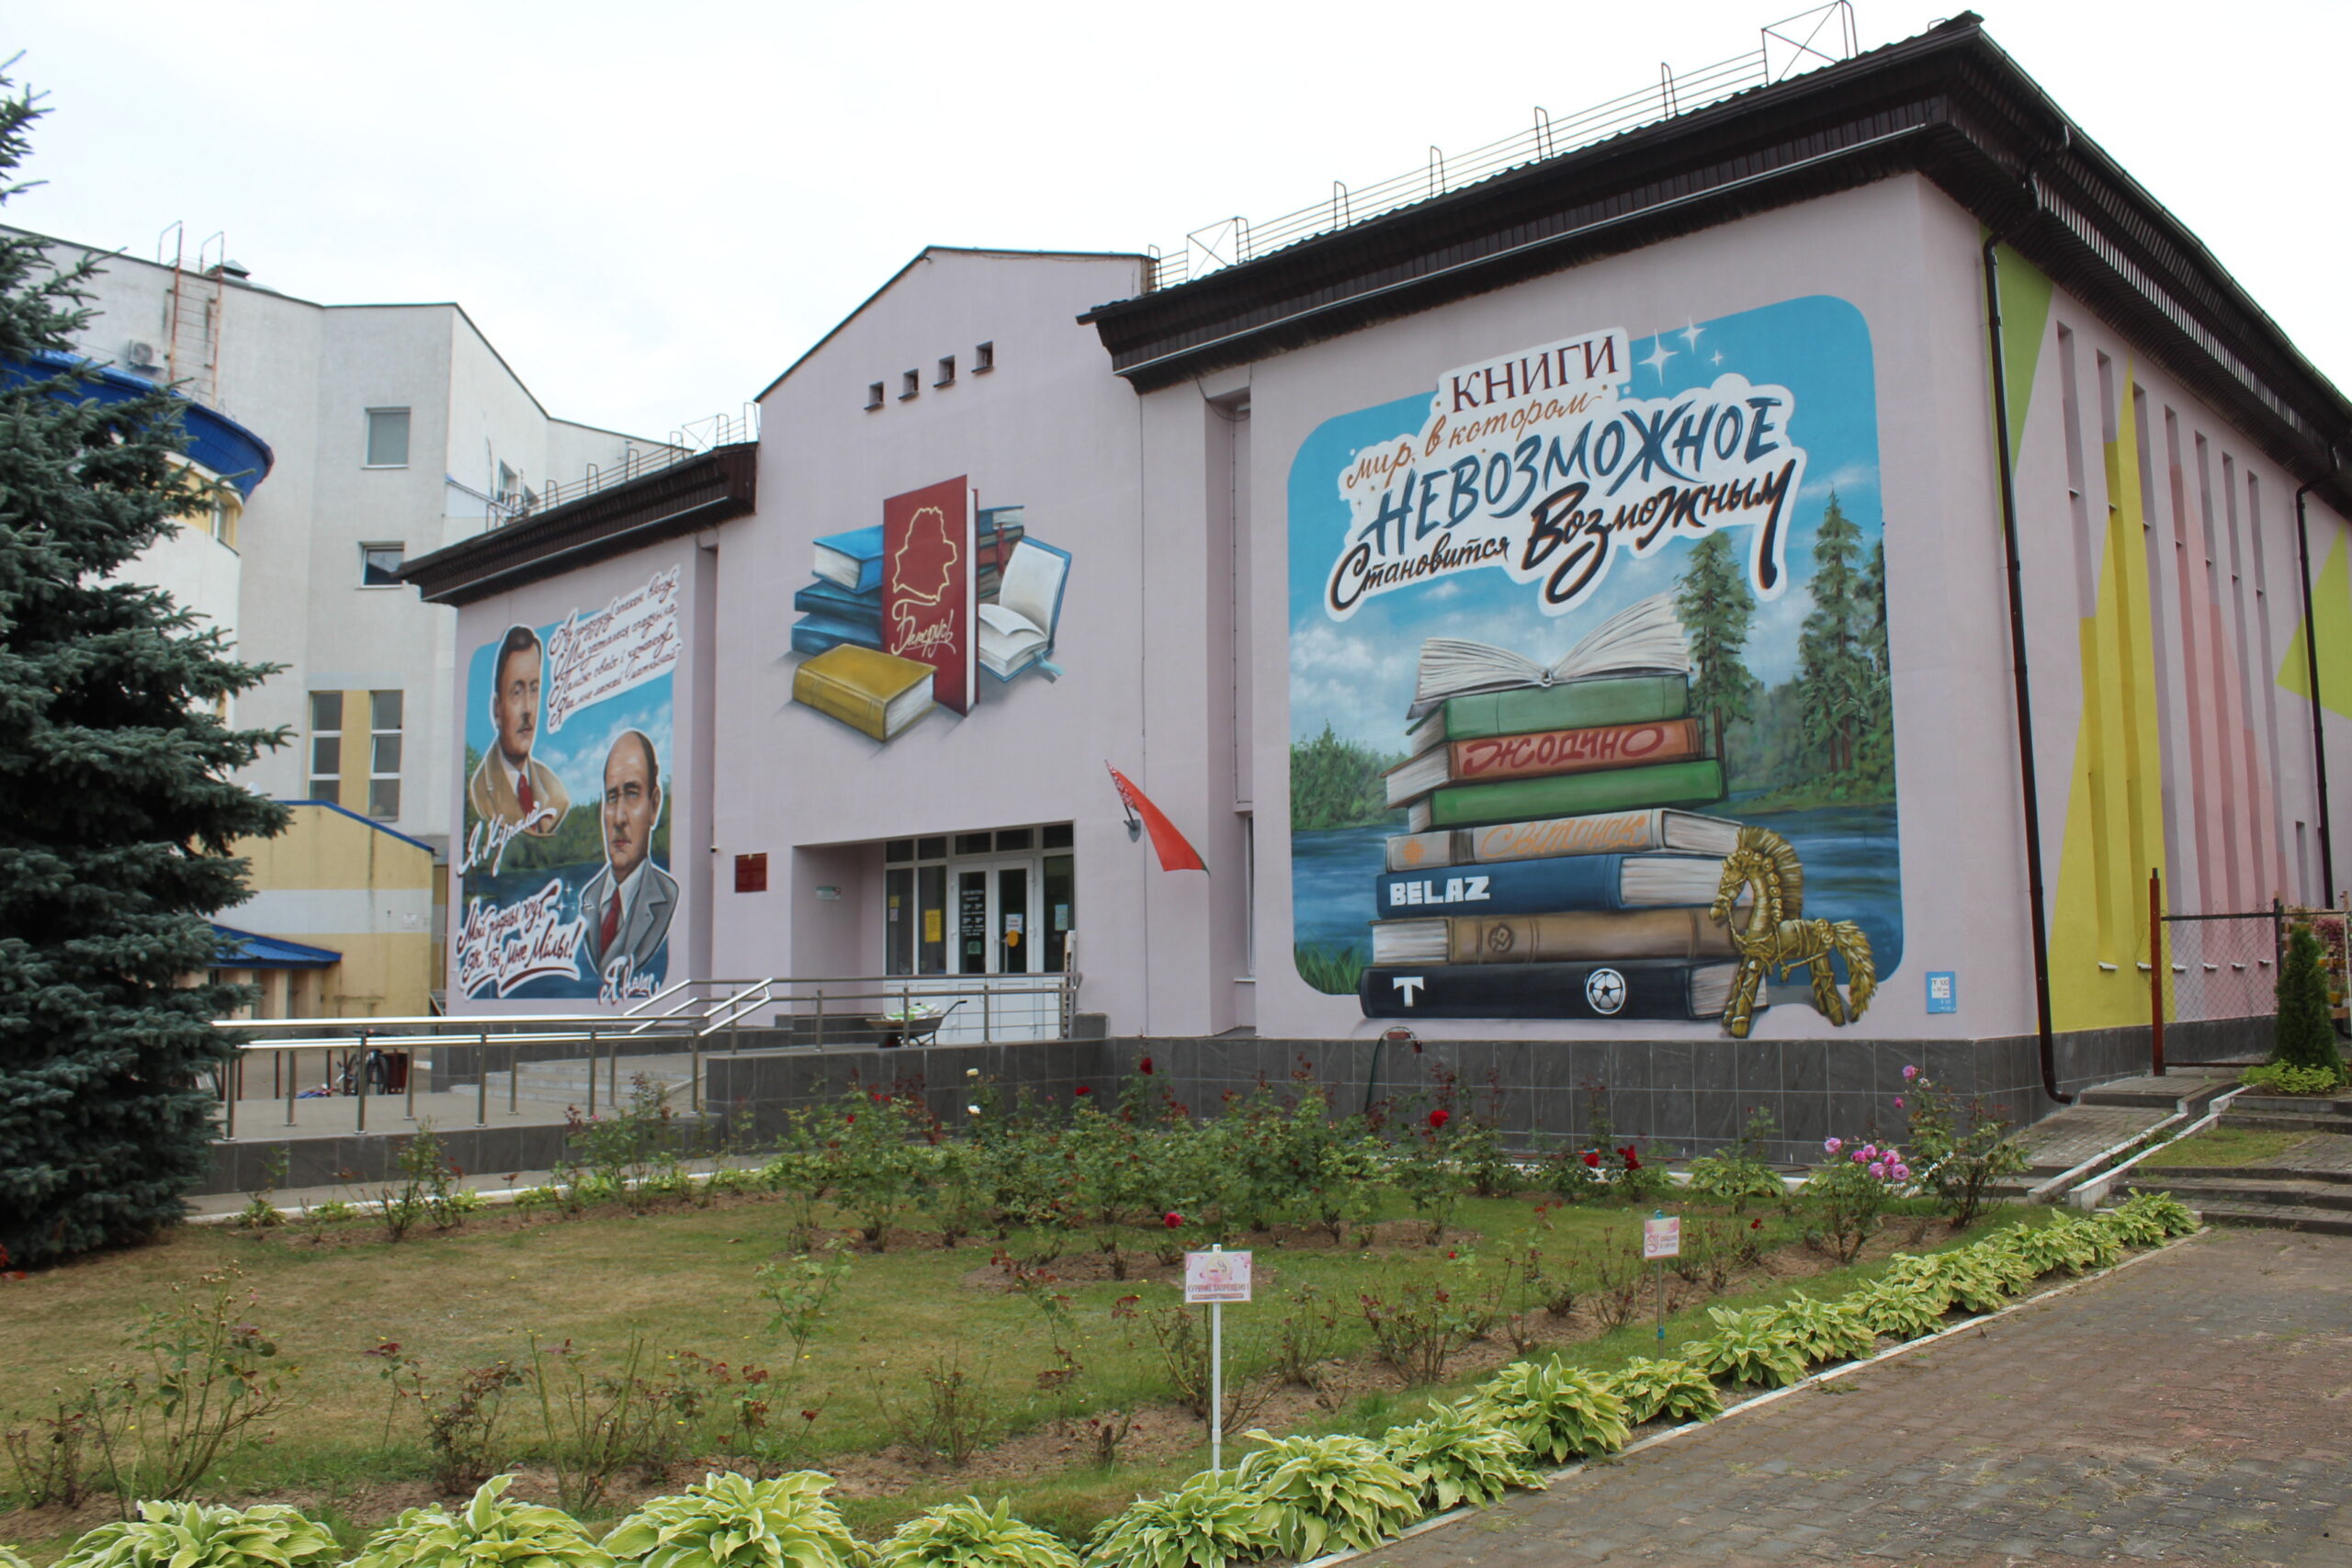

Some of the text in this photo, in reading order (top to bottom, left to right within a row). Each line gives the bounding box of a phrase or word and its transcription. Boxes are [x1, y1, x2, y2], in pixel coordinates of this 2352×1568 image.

[1450, 335, 1619, 413] КНИГИ
[1425, 415, 1444, 454] в
[1448, 391, 1602, 446] котором
[1357, 397, 1781, 556] НЕВОЗМОЖНОЕ
[1330, 458, 1796, 611] Становится Возможным
[1389, 874, 1491, 907] BELAZ
